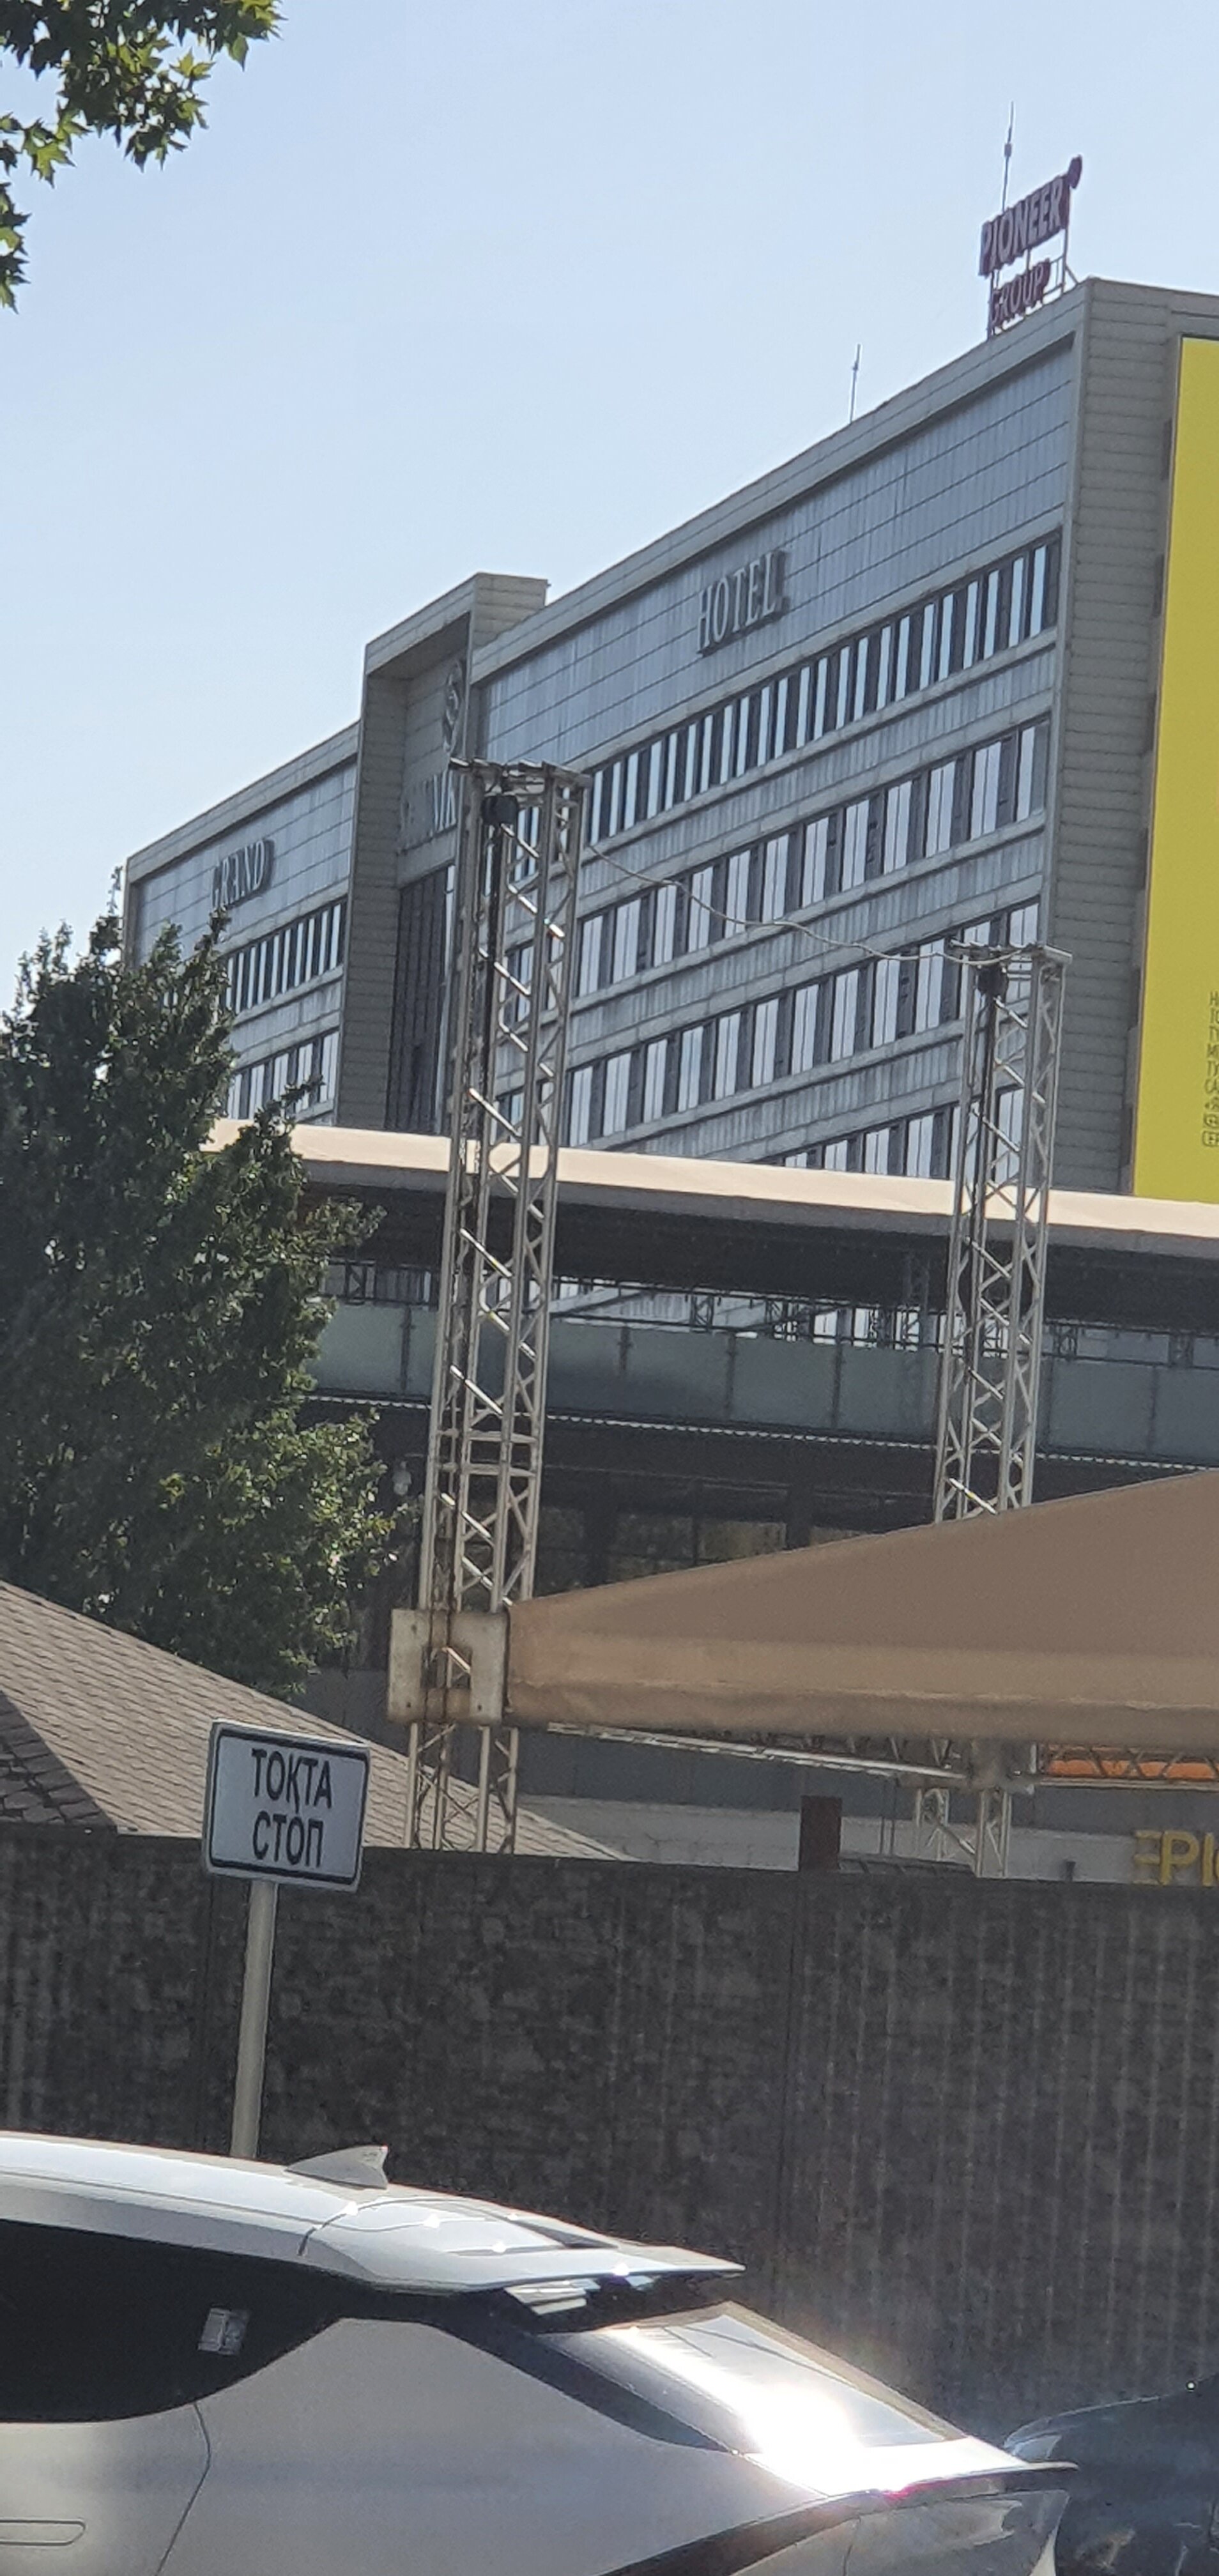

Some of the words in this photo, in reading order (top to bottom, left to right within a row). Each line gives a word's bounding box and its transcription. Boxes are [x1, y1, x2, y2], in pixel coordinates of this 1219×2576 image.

[978, 176, 1071, 276] PIONEER
[990, 259, 1050, 328] GROUP
[697, 552, 778, 656] HOTEL
[252, 1748, 332, 1814] ТОҚТА
[252, 1811, 324, 1868] СТОП
[1133, 1829, 1219, 1887] EPI
